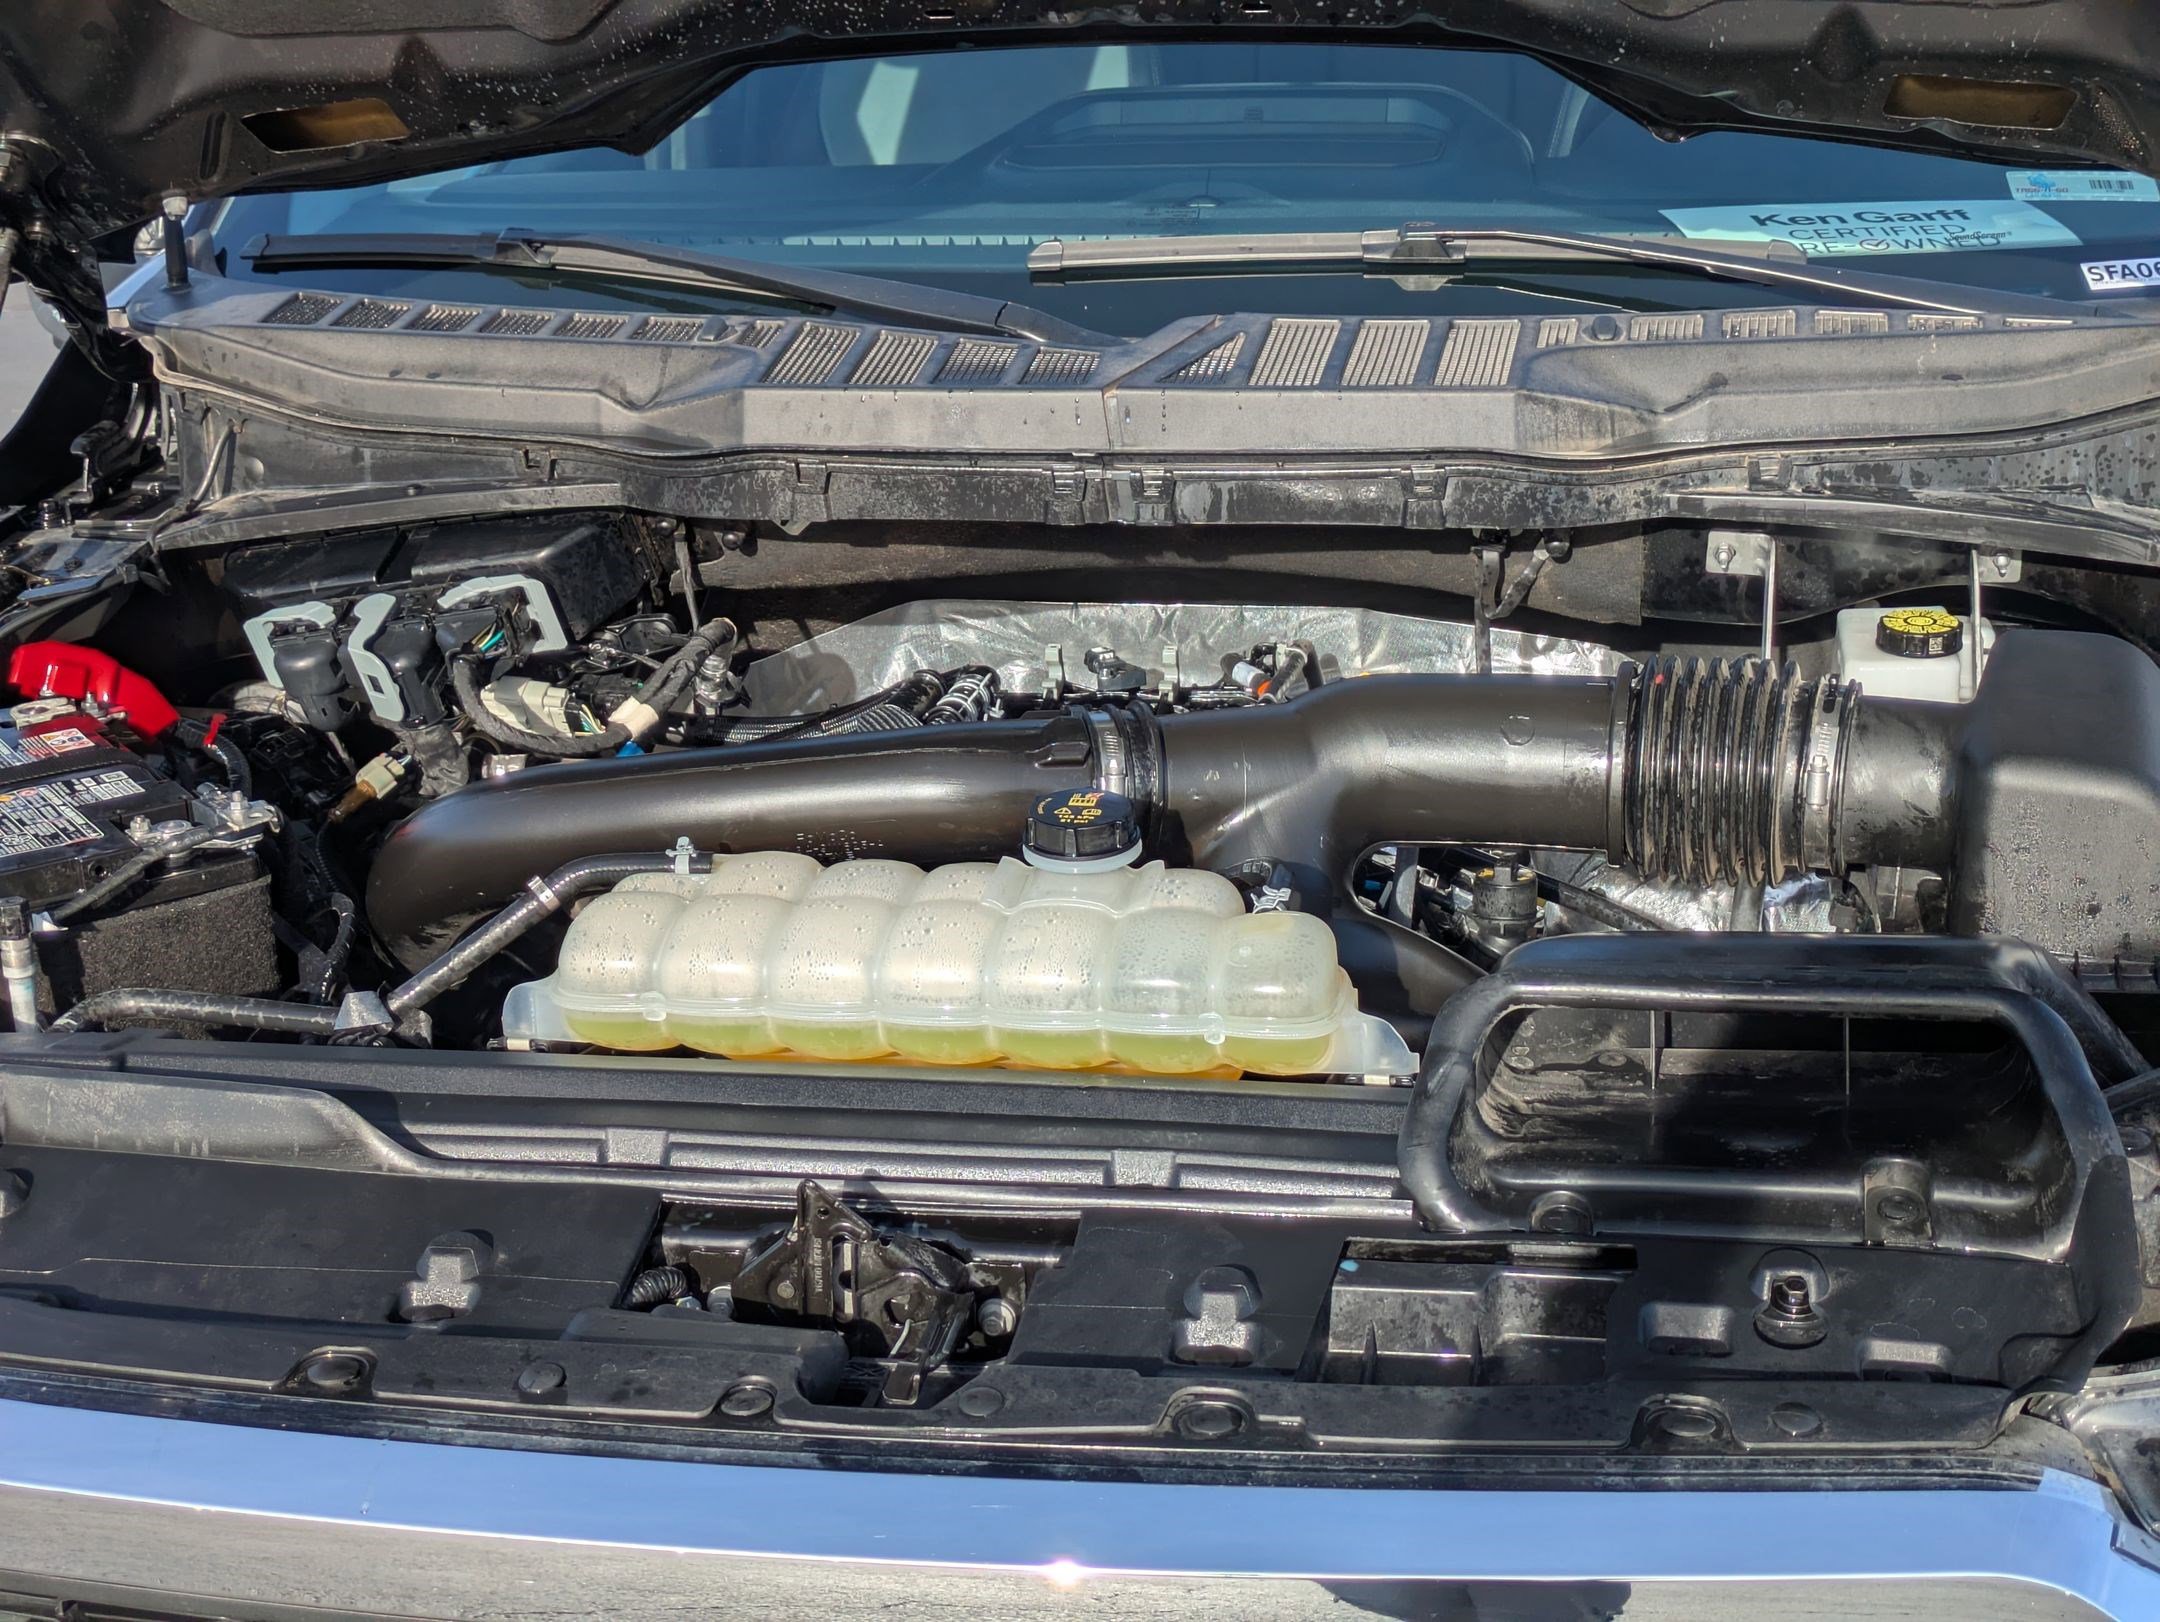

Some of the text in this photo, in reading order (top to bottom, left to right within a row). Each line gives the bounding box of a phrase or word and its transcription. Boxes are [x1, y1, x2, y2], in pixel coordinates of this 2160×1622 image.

[1749, 209, 1971, 226] Ken Garff
[1788, 224, 1966, 240] CERTIFIED
